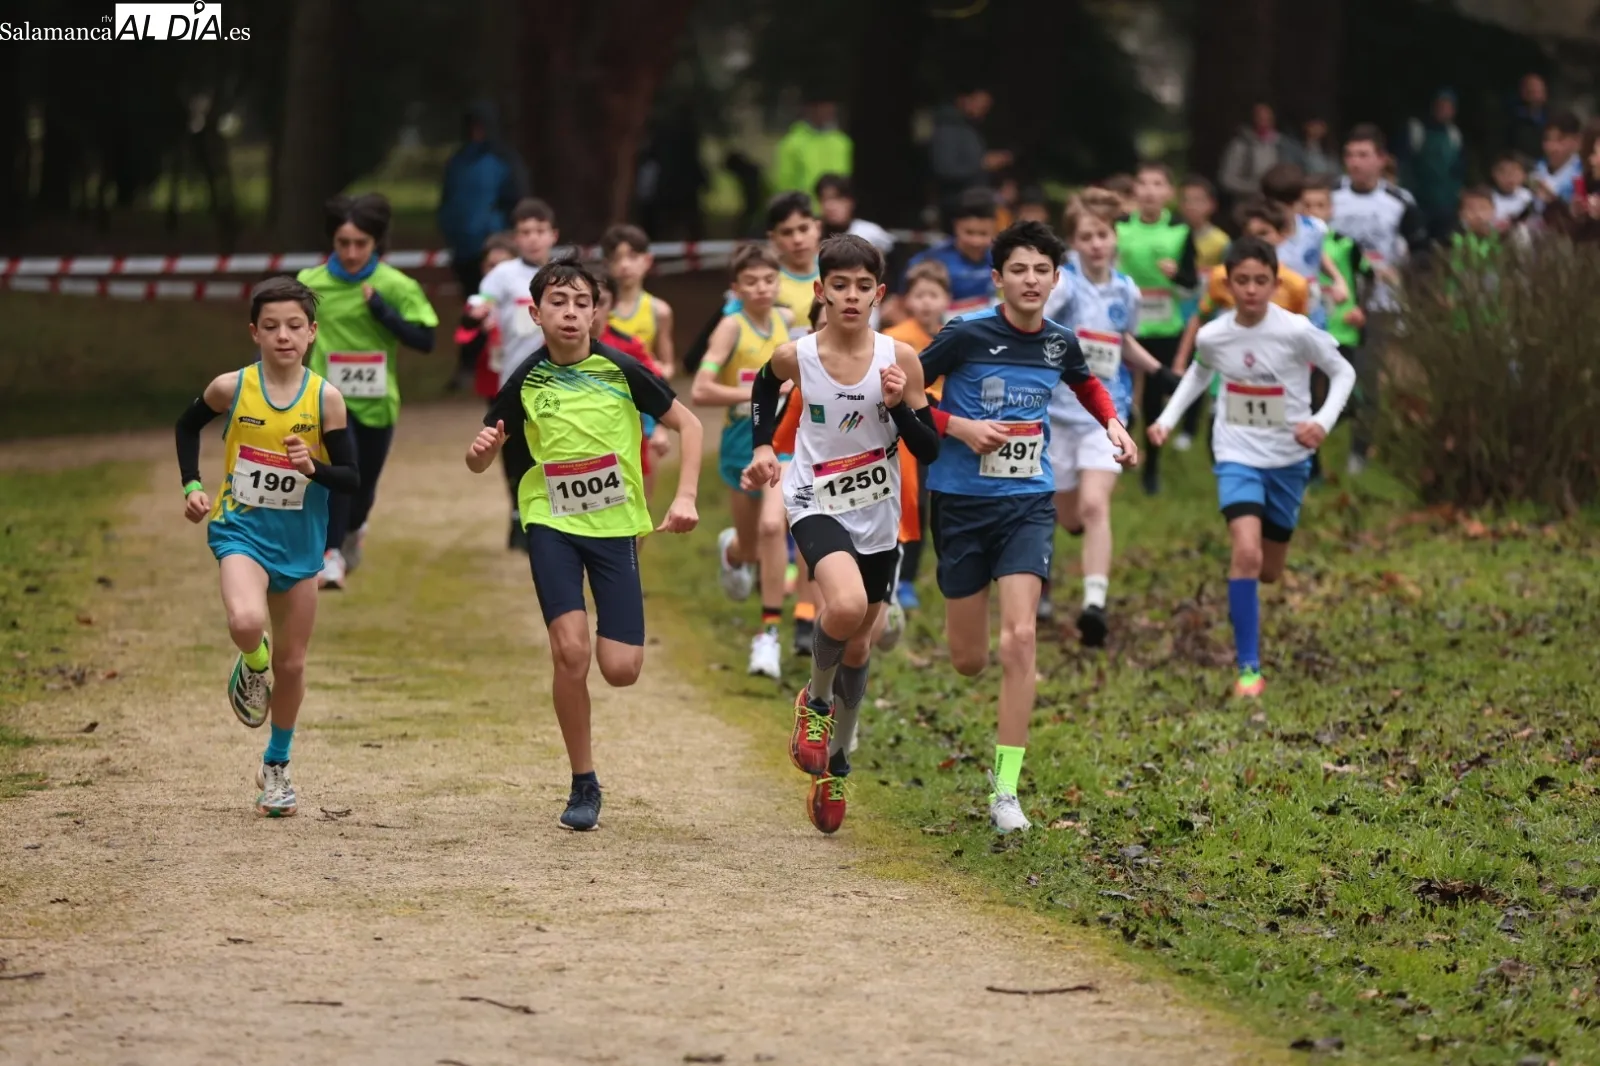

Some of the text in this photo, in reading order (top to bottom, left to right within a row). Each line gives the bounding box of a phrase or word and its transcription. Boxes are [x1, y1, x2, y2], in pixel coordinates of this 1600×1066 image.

[340, 366, 377, 383] 242
[1245, 400, 1267, 415] 11
[998, 442, 1038, 460] 497
[250, 470, 296, 493] 190
[556, 471, 620, 499] 1004
[823, 466, 887, 497] 1250
